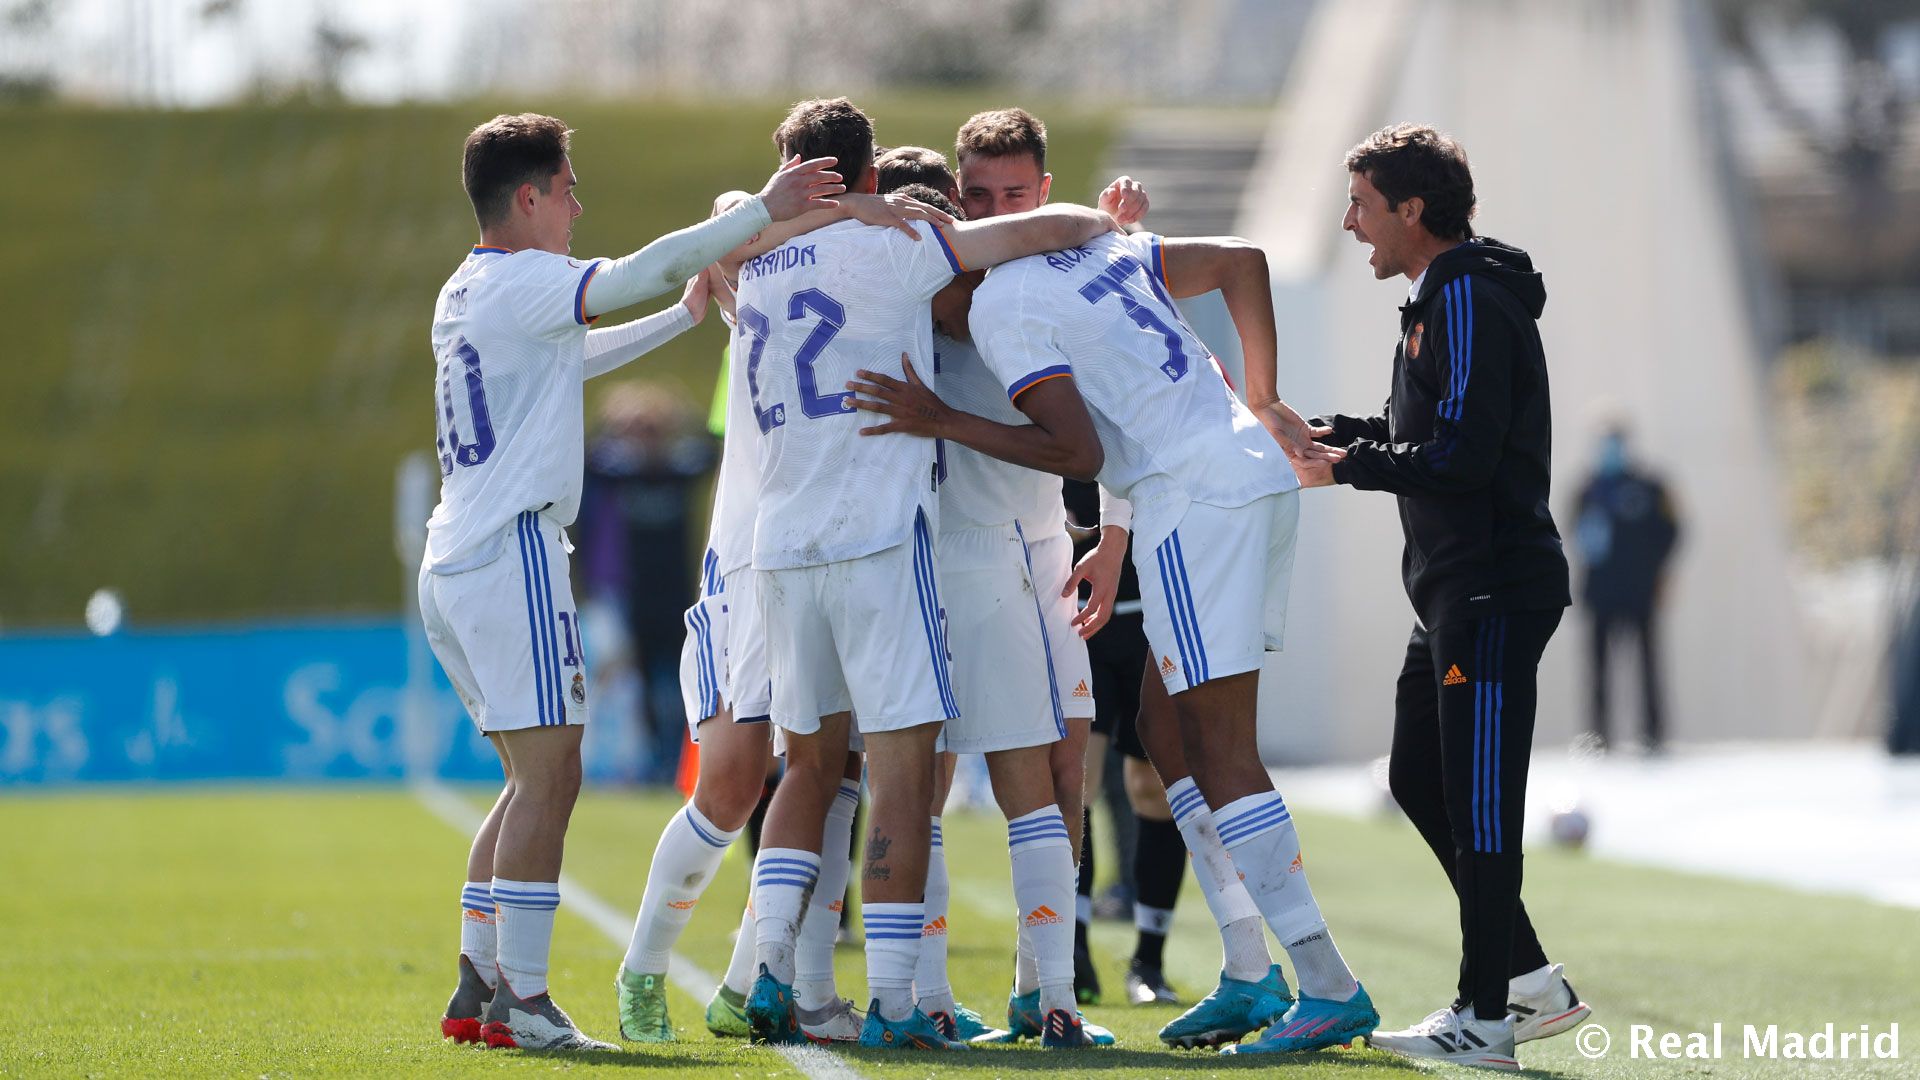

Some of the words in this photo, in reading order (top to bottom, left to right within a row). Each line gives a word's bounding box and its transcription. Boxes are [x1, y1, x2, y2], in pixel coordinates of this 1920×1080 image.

[1077, 255, 1212, 383] 37
[737, 287, 858, 436] 22
[1443, 676, 1467, 686] adidas
[1025, 915, 1063, 927] adidas
[1291, 933, 1322, 948] adidas
